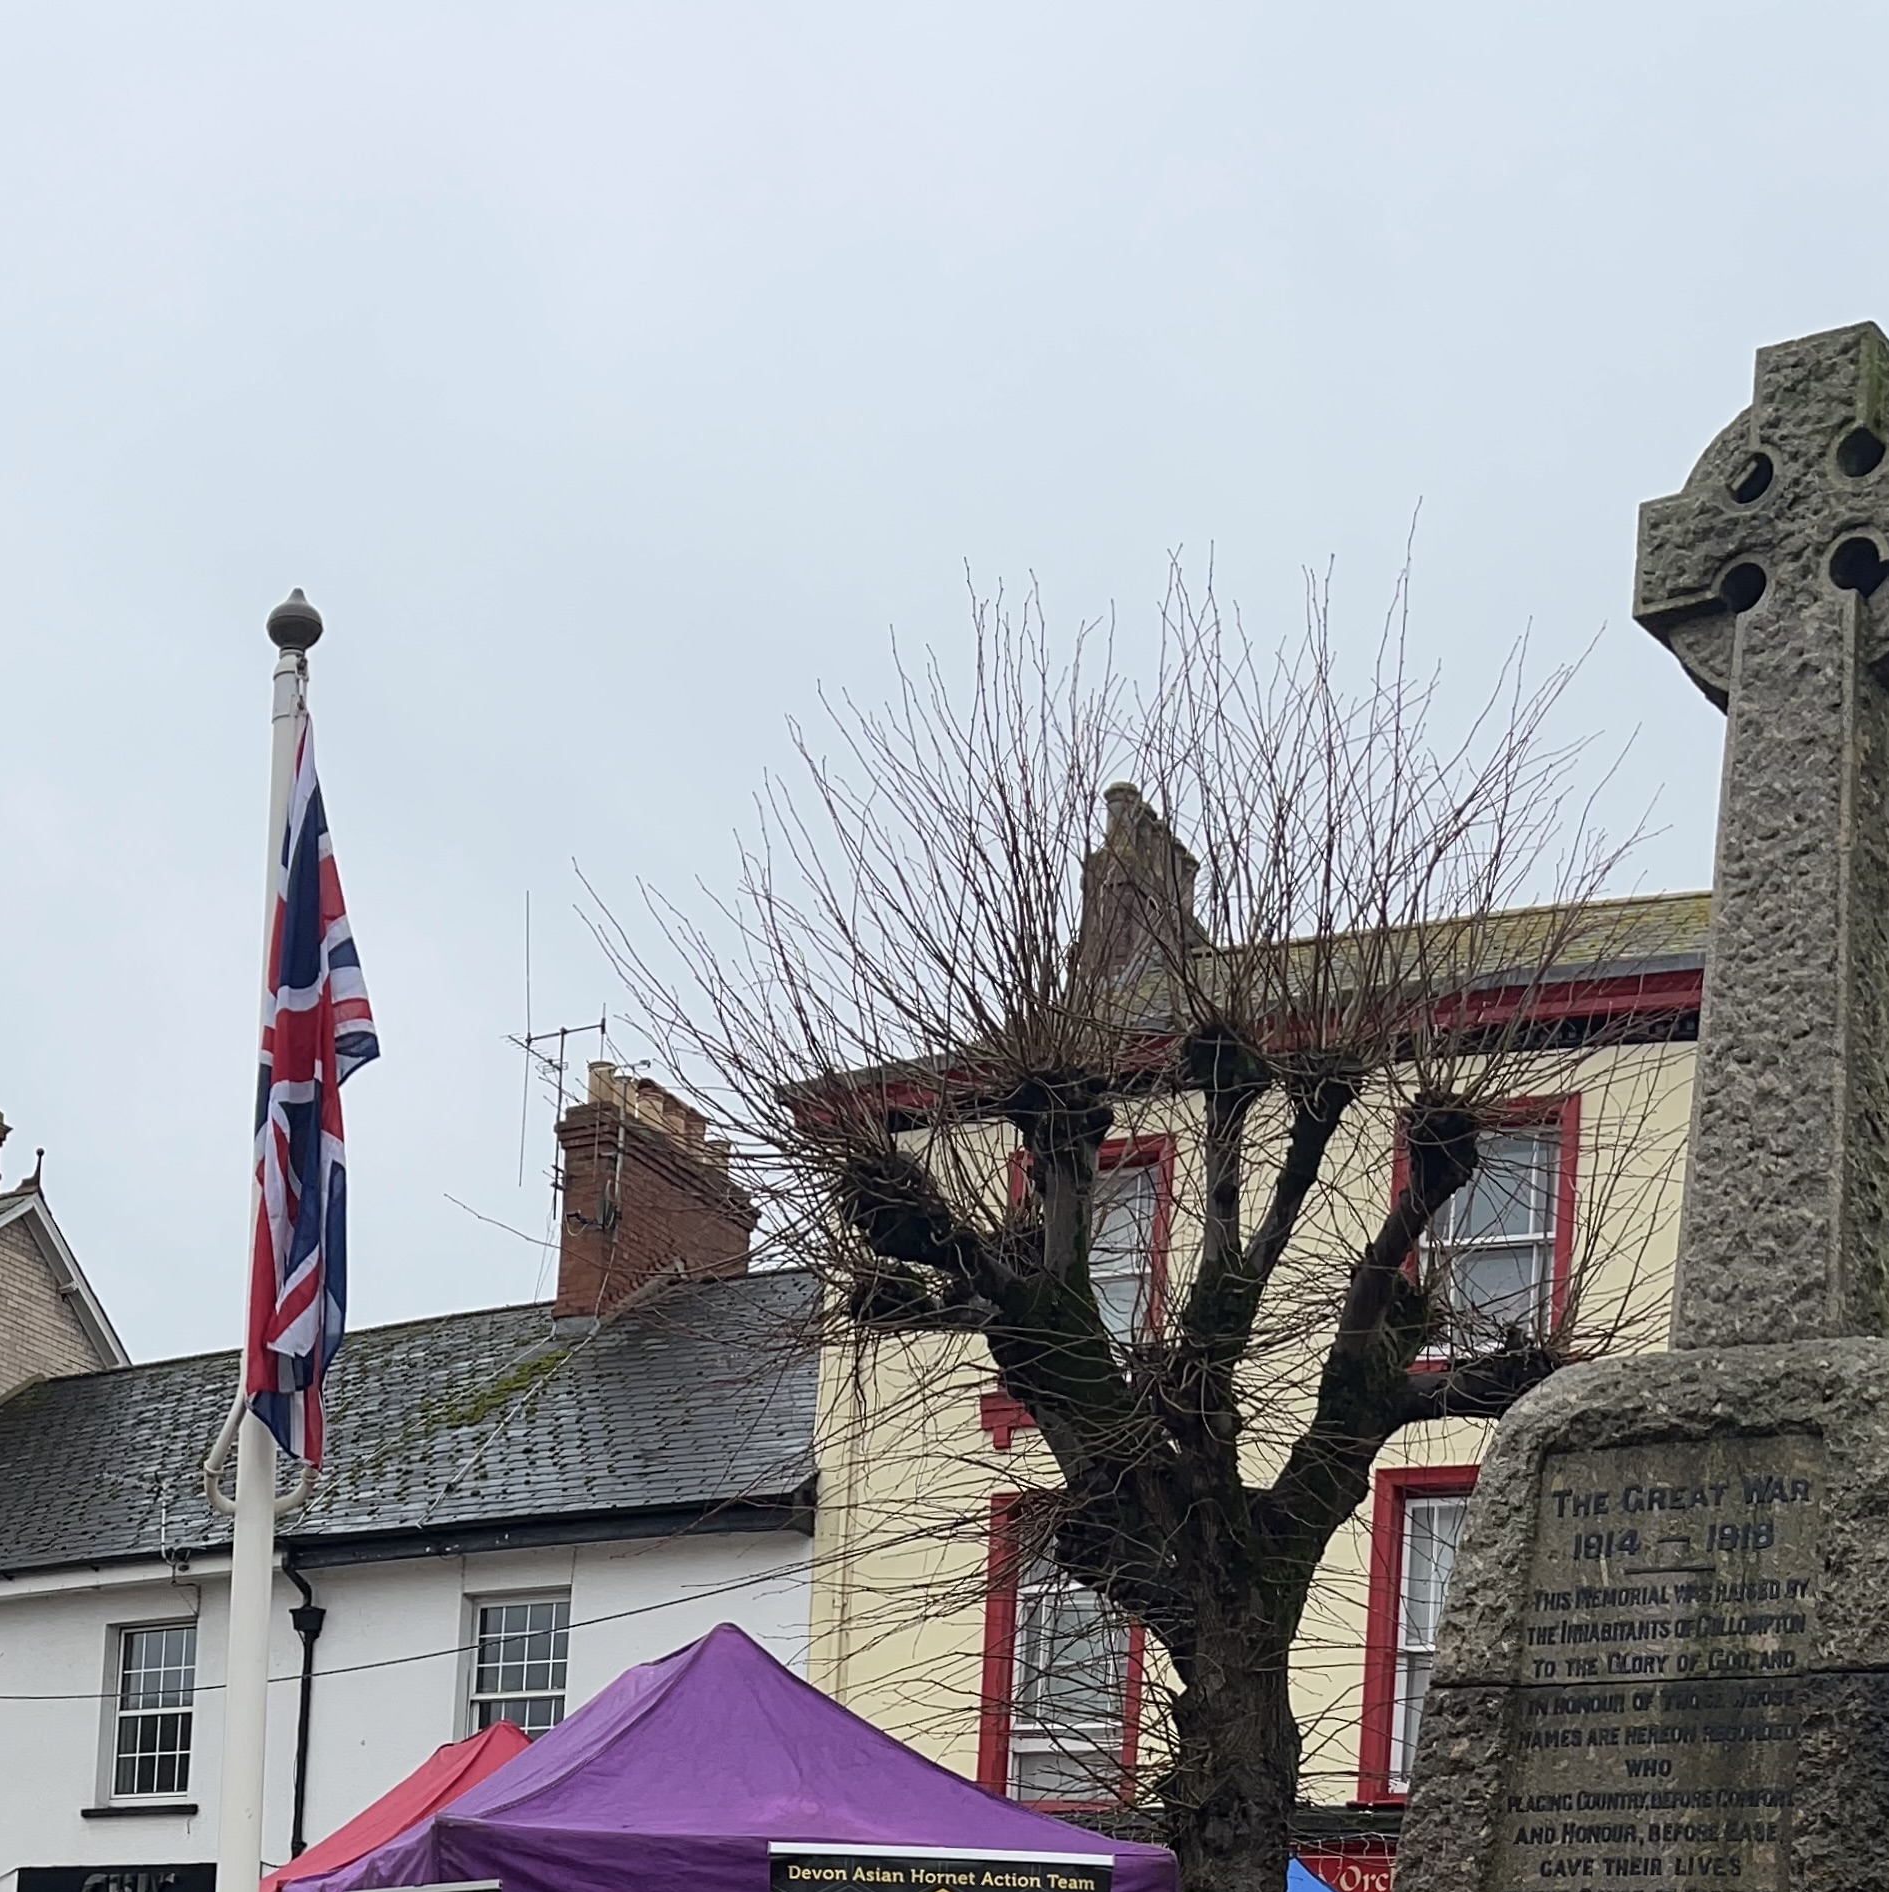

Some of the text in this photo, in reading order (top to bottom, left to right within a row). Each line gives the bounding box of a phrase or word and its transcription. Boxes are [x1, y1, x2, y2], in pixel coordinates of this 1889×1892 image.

[1552, 1475, 1811, 1518] THE GREAT WAR
[1574, 1521, 1774, 1561] 1914 1918
[1533, 1589, 1571, 1612] THIS
[1575, 1584, 1669, 1609] MEMORIAL
[1786, 1577, 1810, 1599] BY
[1528, 1612, 1806, 1646] THE INHABITANTS OF CULLOMPTON
[1532, 1659, 1556, 1679] TO
[1565, 1657, 1598, 1677] THE
[1607, 1651, 1669, 1675] GLORY
[1676, 1653, 1699, 1673] OF
[1759, 1650, 1797, 1670] AND
[1553, 1693, 1625, 1716] HONOUR
[1632, 1692, 1653, 1712] OF
[1518, 1728, 1582, 1749] NAMES
[1586, 1727, 1621, 1747] ARE
[1624, 1725, 1697, 1746] HEREON
[1625, 1759, 1671, 1778] WHO
[1508, 1793, 1573, 1813] PLACING
[1513, 1825, 1556, 1845] AND
[1648, 1821, 1719, 1843] BEFORE
[788, 1865, 1095, 1891] Devon Asian Hornet Action Team
[1540, 1856, 1742, 1878] GAVE THEIR LIVES
